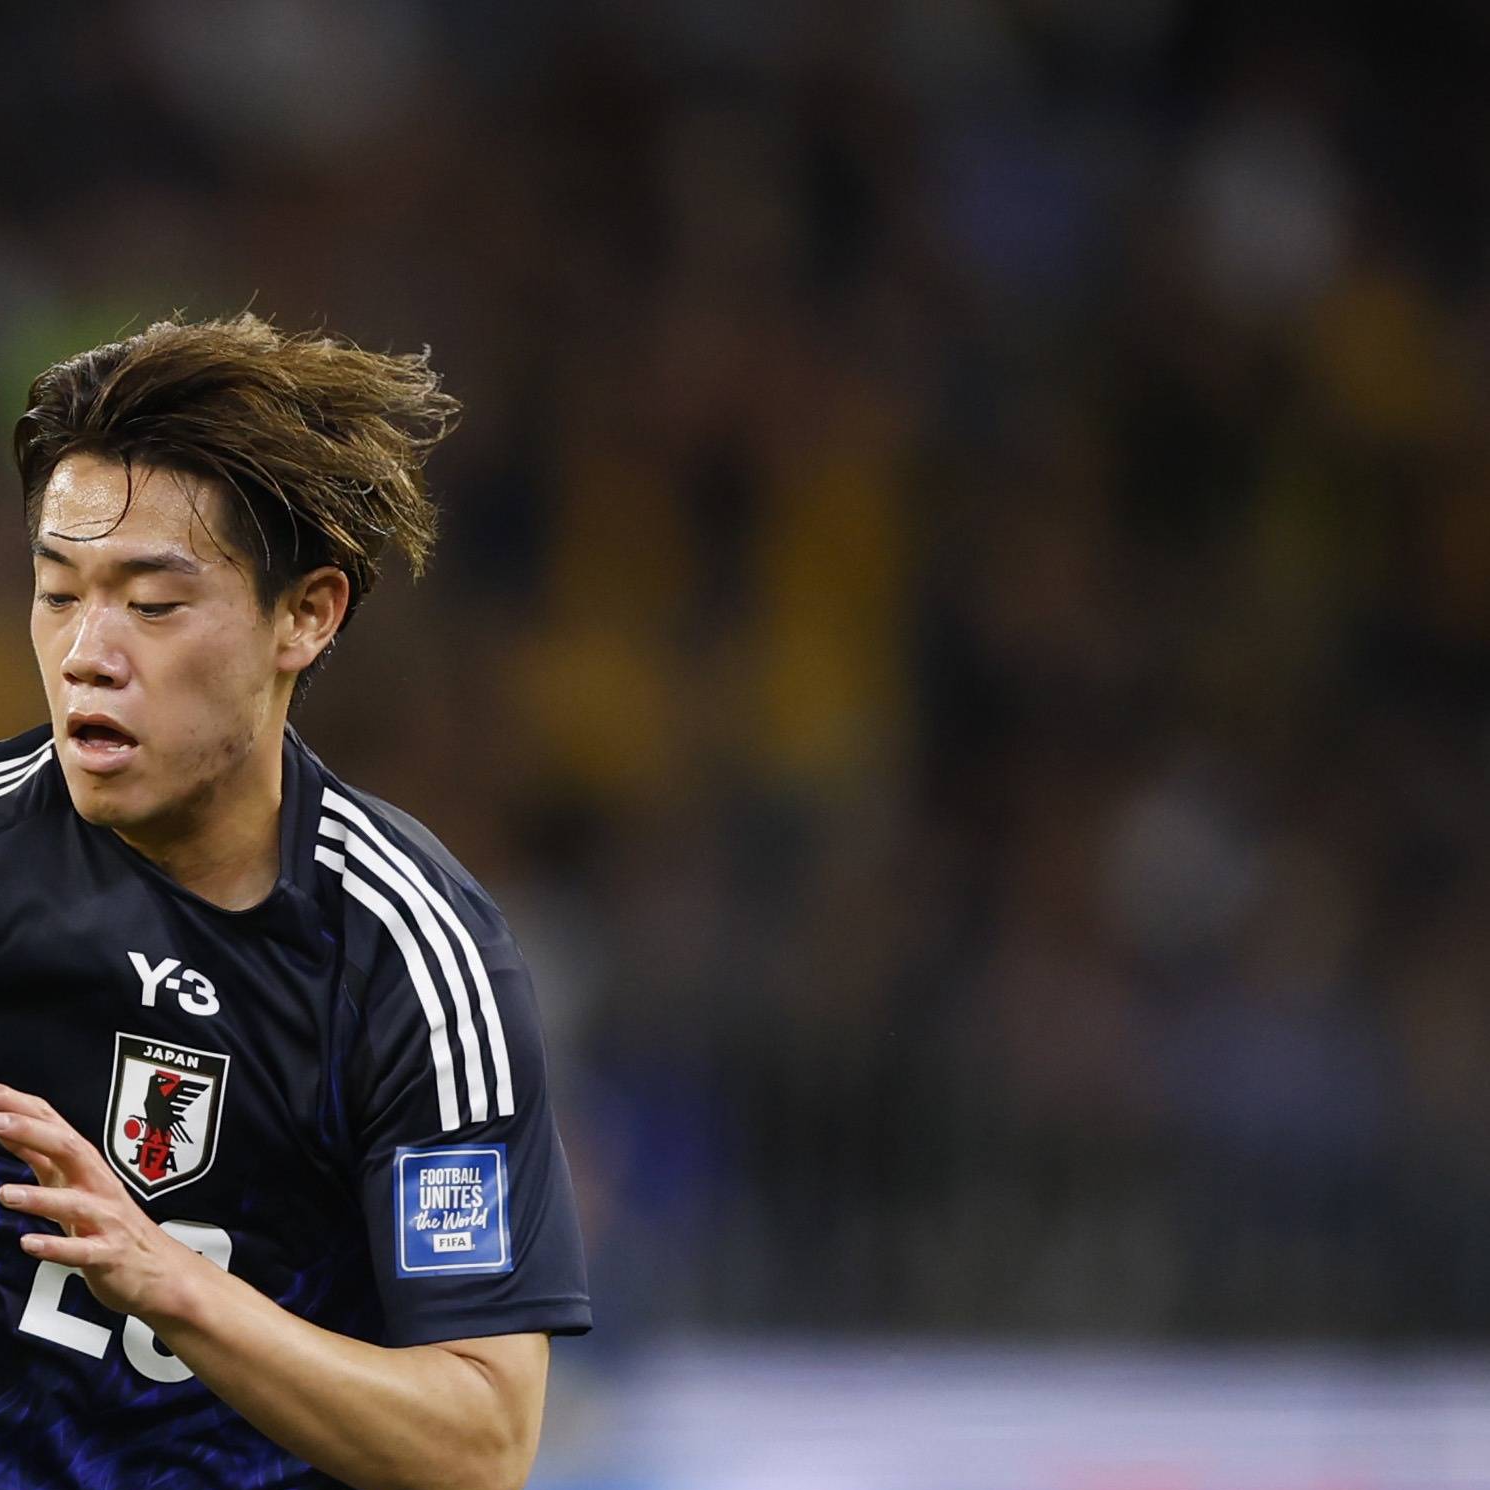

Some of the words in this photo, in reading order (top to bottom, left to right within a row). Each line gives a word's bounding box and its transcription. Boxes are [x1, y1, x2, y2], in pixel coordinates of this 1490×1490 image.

[126, 950, 221, 1016] Y-3
[143, 1045, 199, 1069] JAPAN
[128, 1143, 178, 1173] JFA
[419, 1167, 483, 1185] FOOTBALL
[419, 1185, 484, 1210] UNITES
[414, 1210, 441, 1231] the
[442, 1207, 489, 1230] World
[438, 1237, 467, 1248] FIFA
